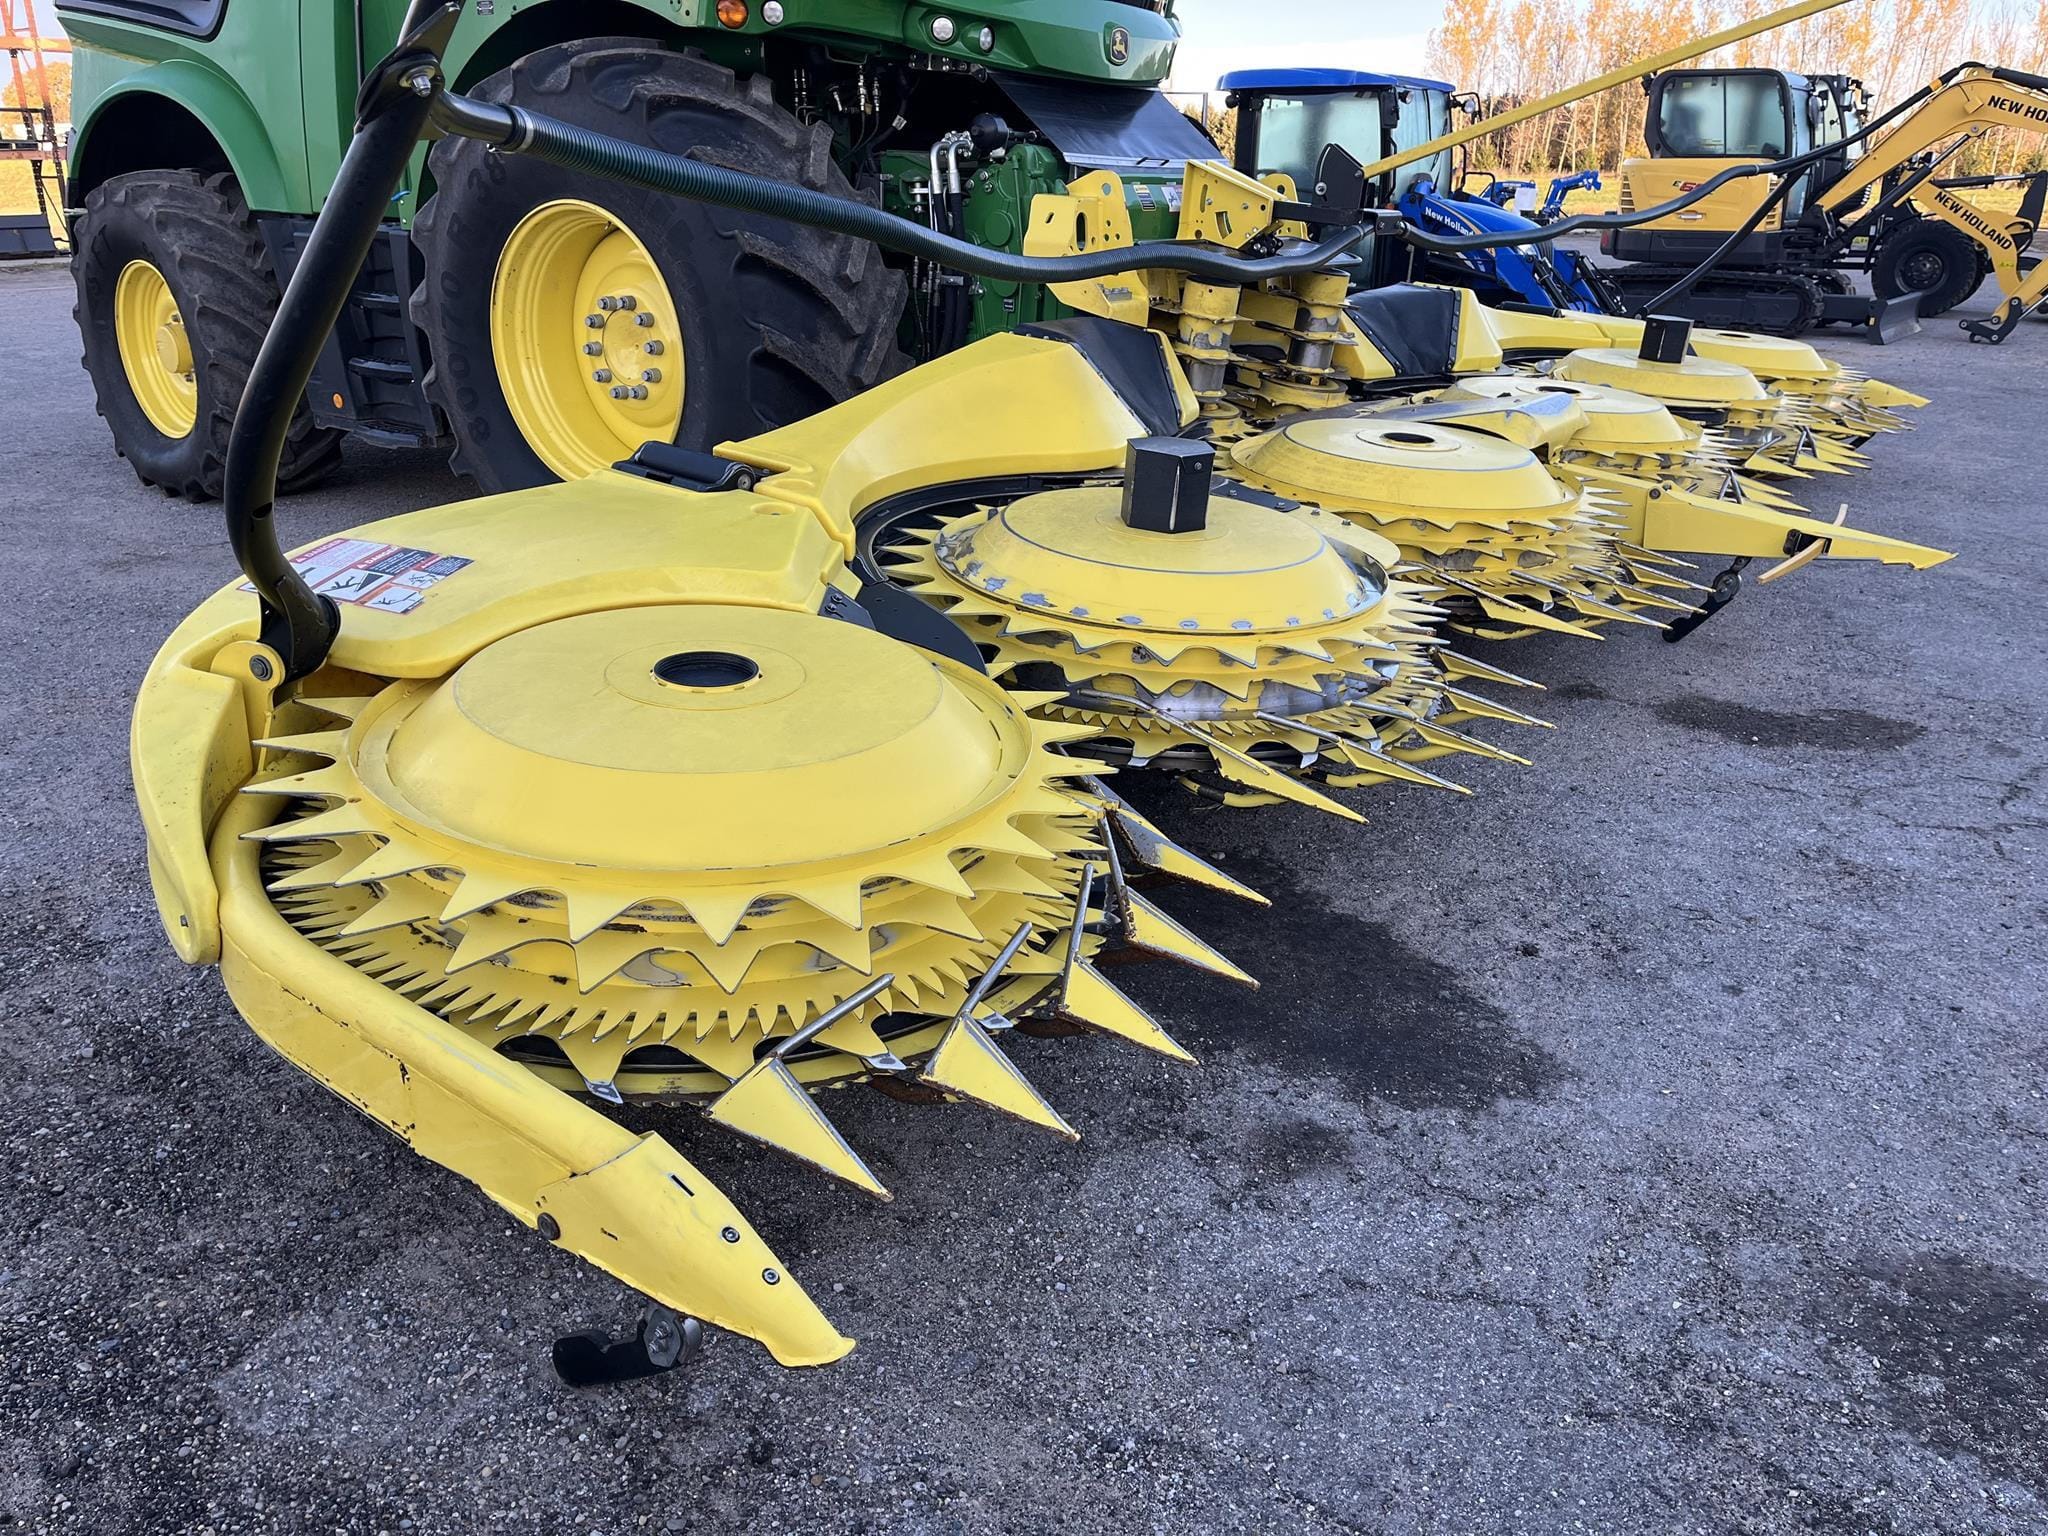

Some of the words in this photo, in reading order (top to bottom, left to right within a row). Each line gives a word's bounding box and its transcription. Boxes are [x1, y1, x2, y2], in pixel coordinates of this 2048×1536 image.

[1987, 95, 2024, 114] NEW
[2023, 105, 2048, 123] HO
[1425, 206, 1444, 222] New
[1444, 215, 1474, 237] Holland
[1934, 191, 1963, 214] NEW
[1960, 208, 2013, 250] HOLLAND
